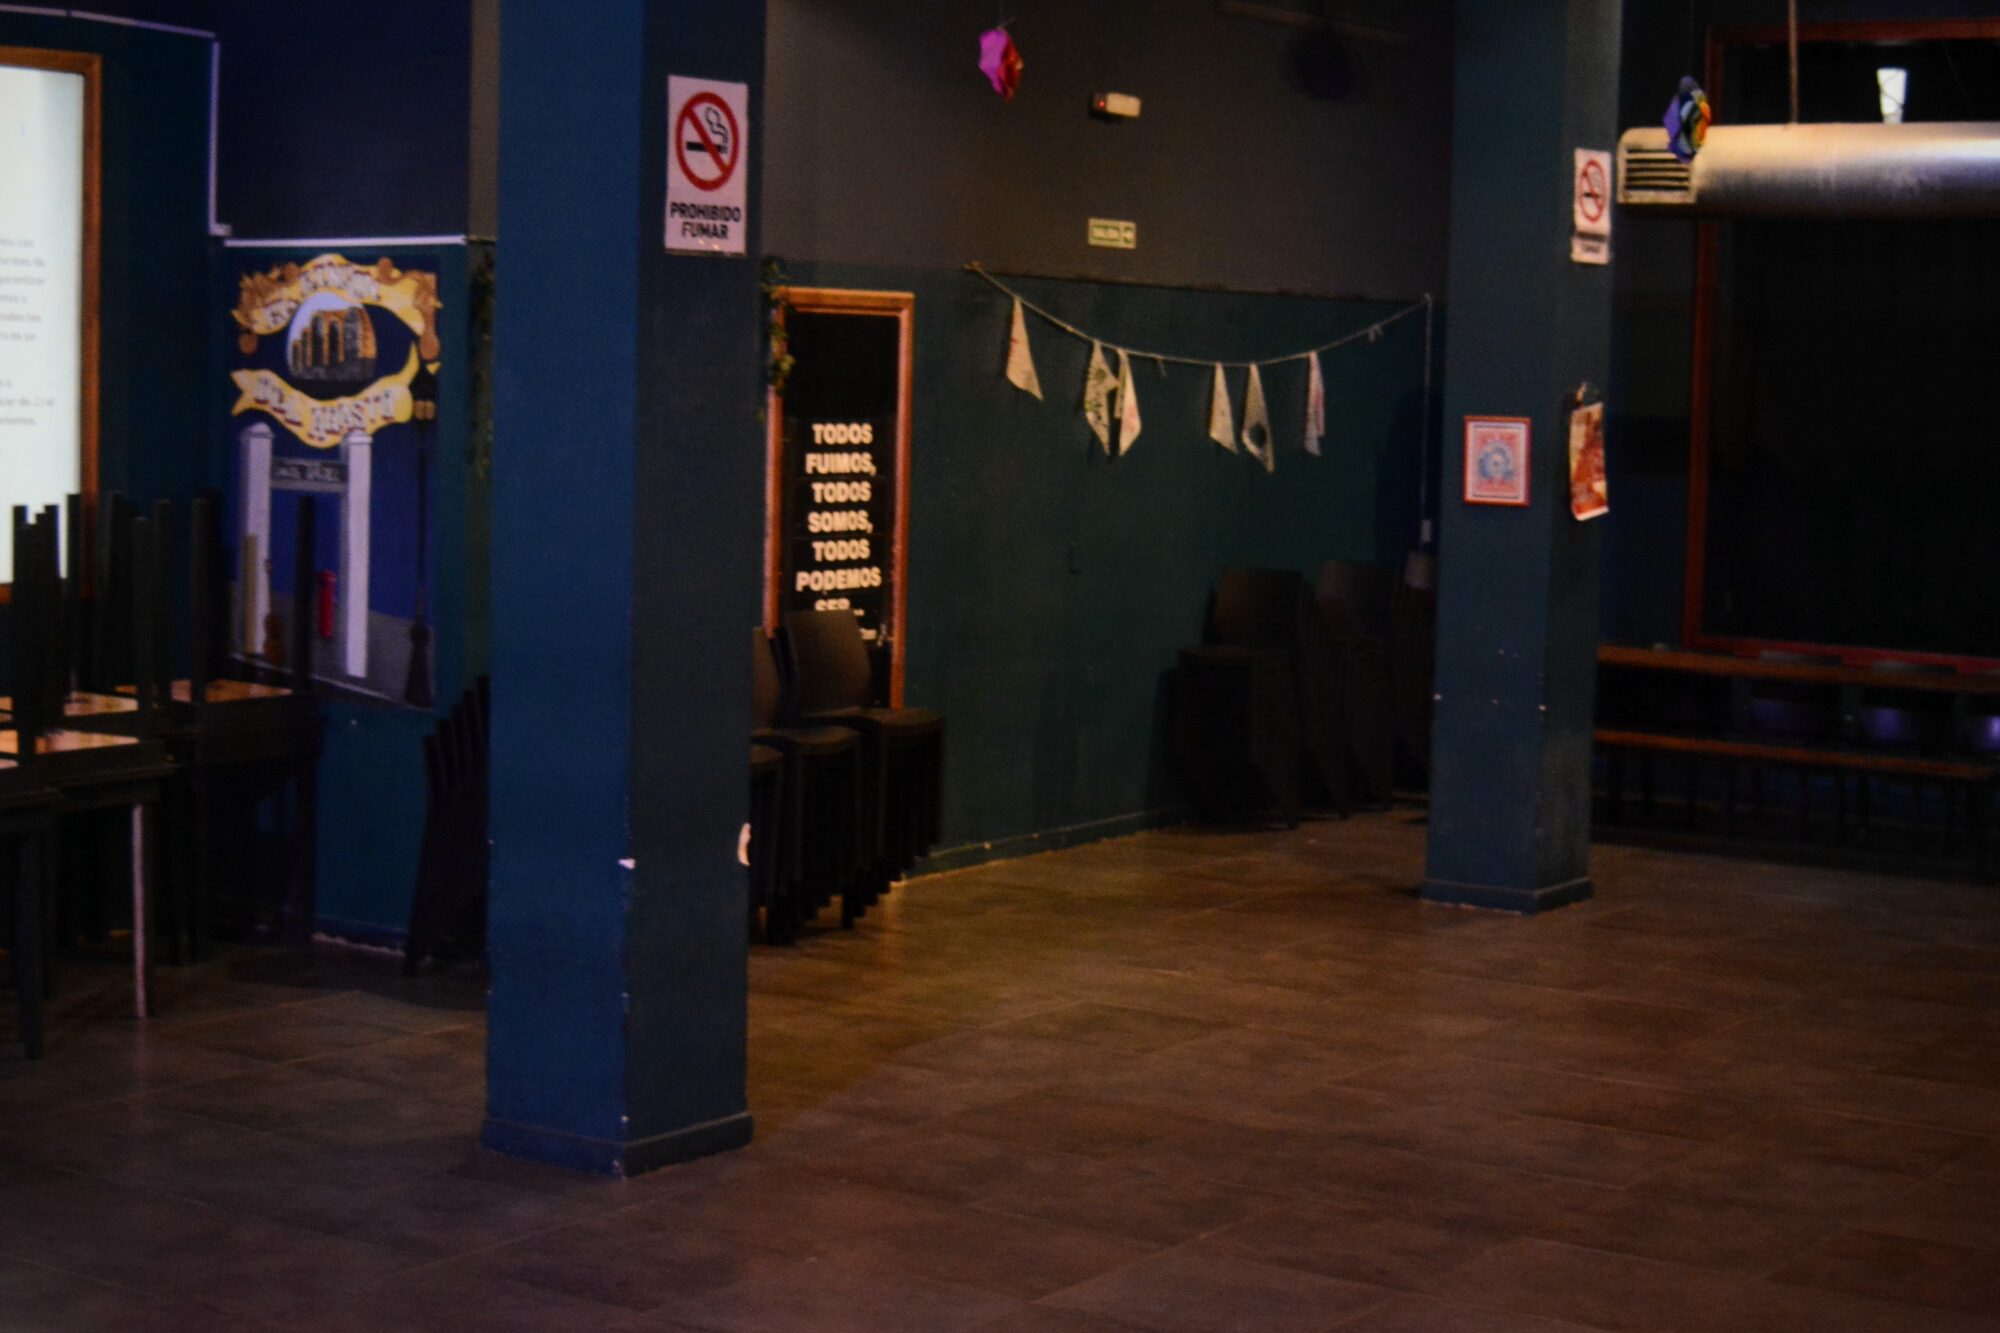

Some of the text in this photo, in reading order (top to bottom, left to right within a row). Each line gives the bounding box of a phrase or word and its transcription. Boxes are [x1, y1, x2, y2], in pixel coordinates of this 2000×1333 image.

[669, 202, 741, 222] PROHIBIDO
[681, 221, 729, 239] FUMAR
[812, 423, 873, 445] TODOS
[805, 452, 877, 476] FUIMOS,
[811, 481, 872, 503] TODOS
[808, 509, 873, 534] SOMOS,
[812, 538, 871, 562] TODOS
[795, 566, 882, 592] PODEMOS
